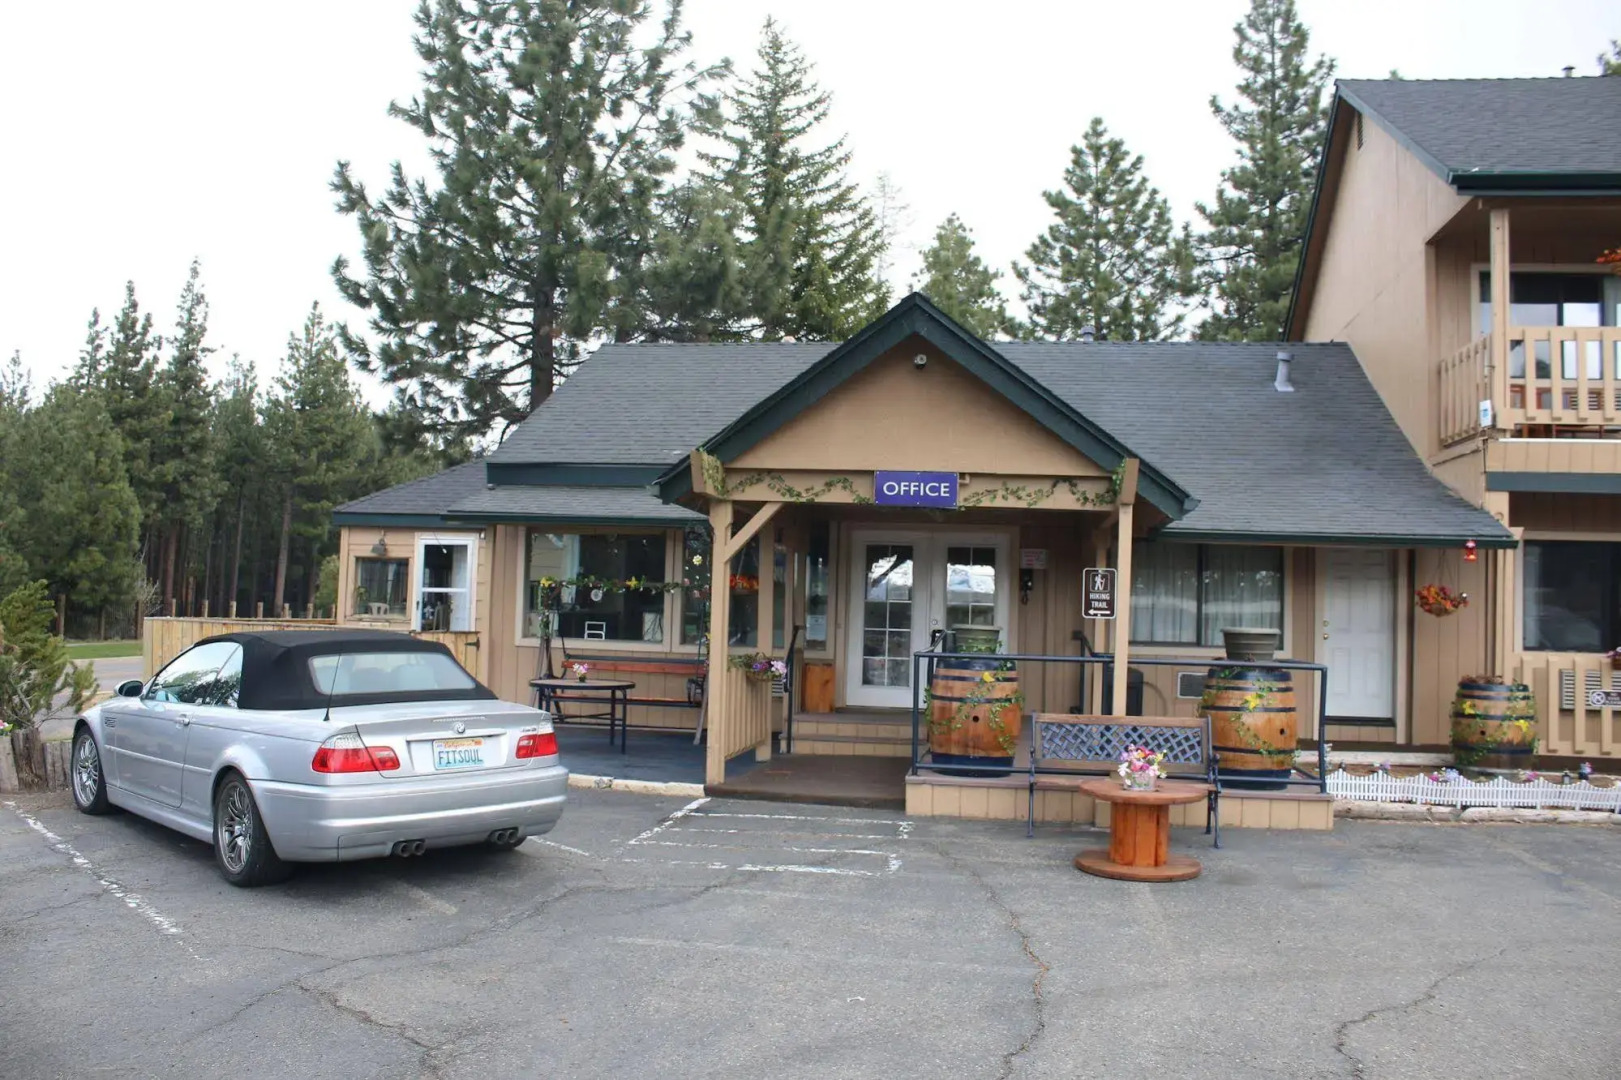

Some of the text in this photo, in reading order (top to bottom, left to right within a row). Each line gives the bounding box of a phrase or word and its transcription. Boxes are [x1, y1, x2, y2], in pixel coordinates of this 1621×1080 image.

[883, 482, 950, 496] OFFICE
[1089, 593, 1110, 601] HIKING
[438, 749, 483, 764] FITSOUL
